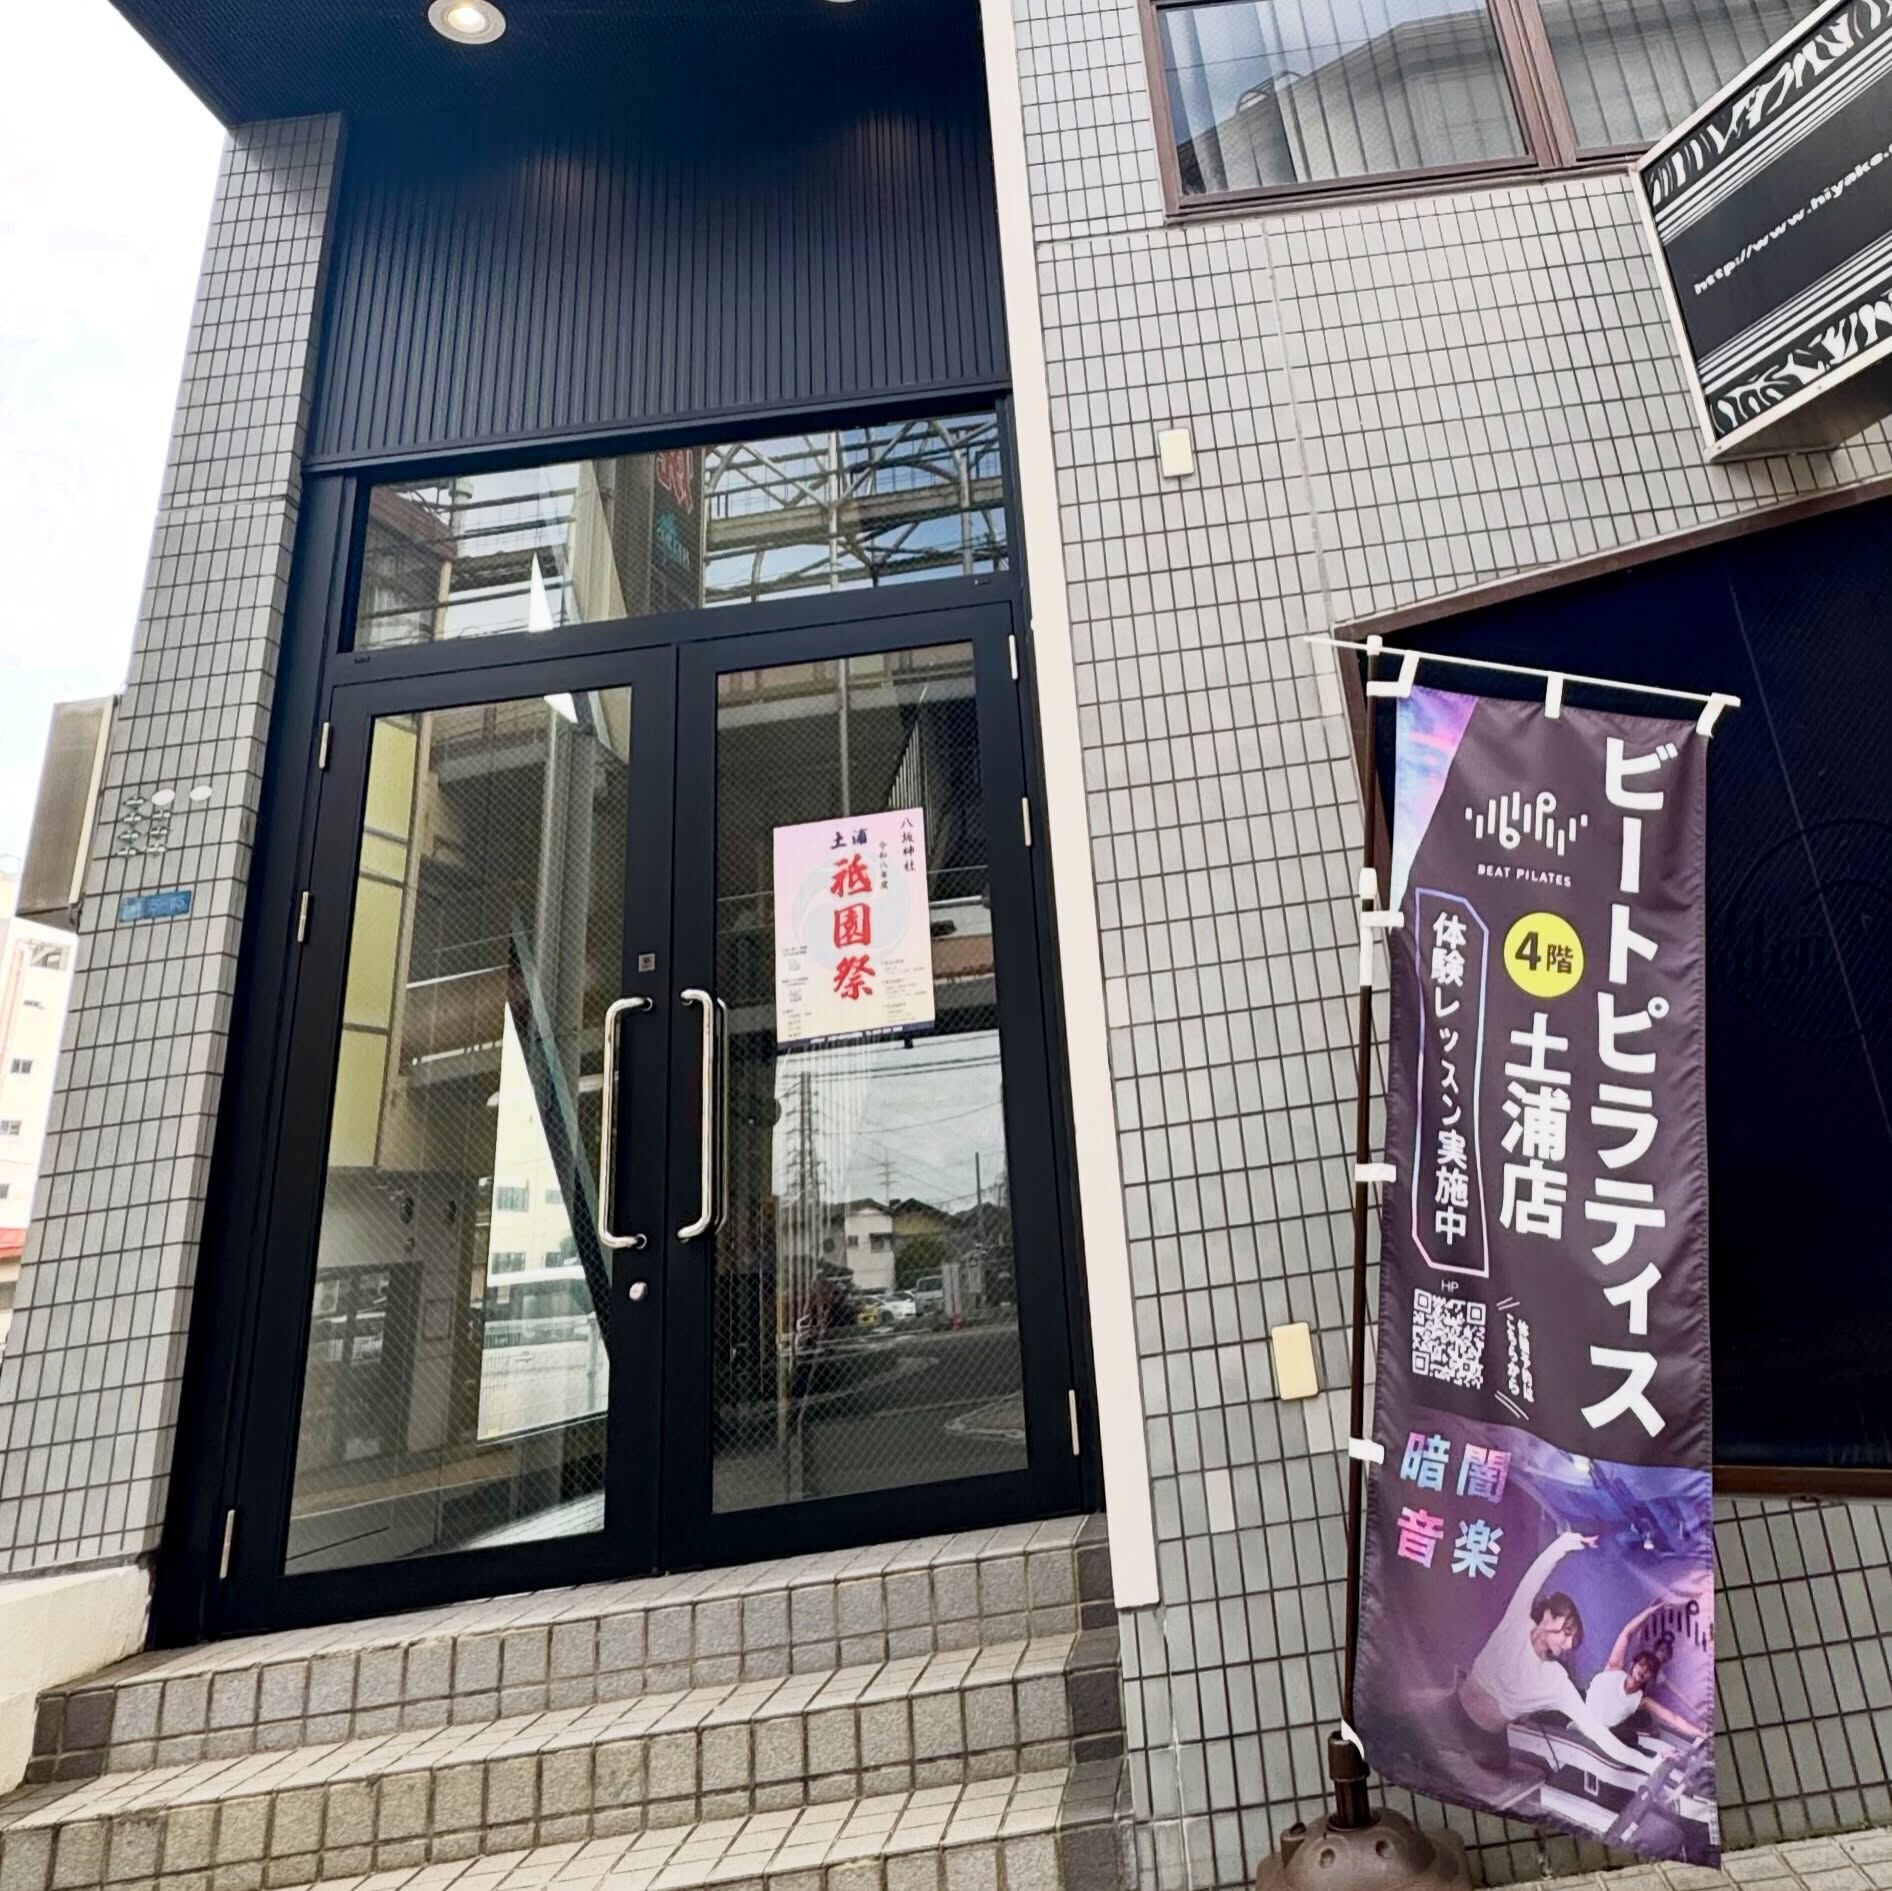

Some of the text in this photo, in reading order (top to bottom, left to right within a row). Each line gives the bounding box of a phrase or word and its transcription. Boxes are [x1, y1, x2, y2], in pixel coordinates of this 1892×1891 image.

[1694, 143, 1892, 295] http://www.hiyake.
[830, 828, 867, 849] 土浦
[1477, 863, 1572, 887] BEAT PILATES
[1514, 931, 1574, 974] 4階
[1431, 911, 1469, 1245] 体験レッスン実施中
[1581, 737, 1678, 1438] ビートピラティス
[1499, 1012, 1571, 1240] 土浦店
[1441, 1279, 1459, 1293] HP
[1400, 1432, 1512, 1503] 暗闇
[1397, 1506, 1504, 1579] 音楽
